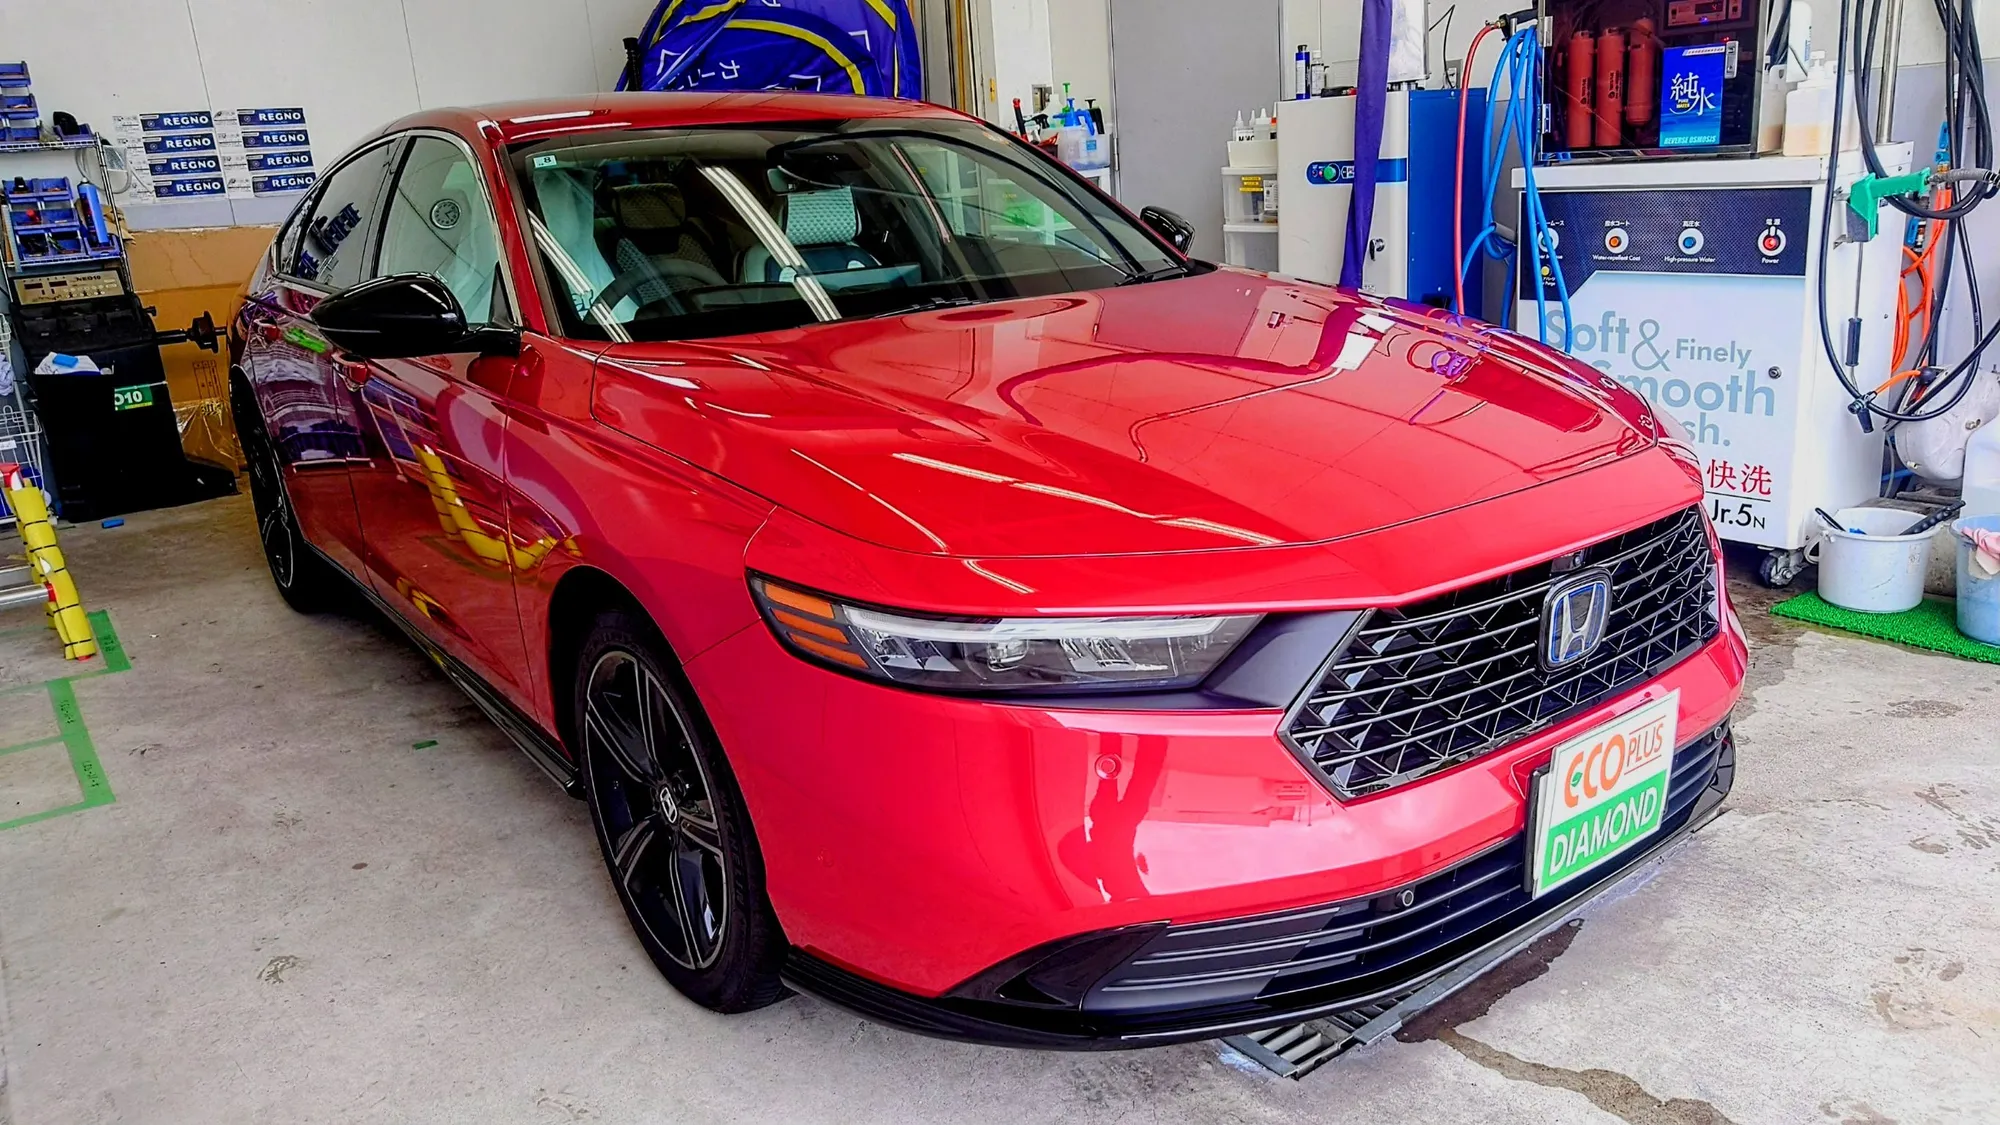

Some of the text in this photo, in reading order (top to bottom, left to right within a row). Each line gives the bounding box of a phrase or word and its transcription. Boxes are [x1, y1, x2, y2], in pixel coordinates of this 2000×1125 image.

[1669, 71, 1716, 116] 純水
[163, 116, 209, 127] REGNO
[259, 112, 302, 122] REGNO
[166, 137, 211, 149] REGNO
[263, 134, 306, 143] REGNO
[1664, 135, 1716, 145] REVERSE OSMOSIS
[171, 159, 216, 171] REGNO
[267, 155, 309, 166] REGNO
[176, 181, 221, 193] REGNO
[272, 177, 314, 188] REGNO
[1545, 310, 1752, 372] Soft & Finely
[1706, 459, 1772, 495] 快洗
[1627, 723, 1664, 767] PLUS
[1549, 786, 1658, 877] DIAMOND
